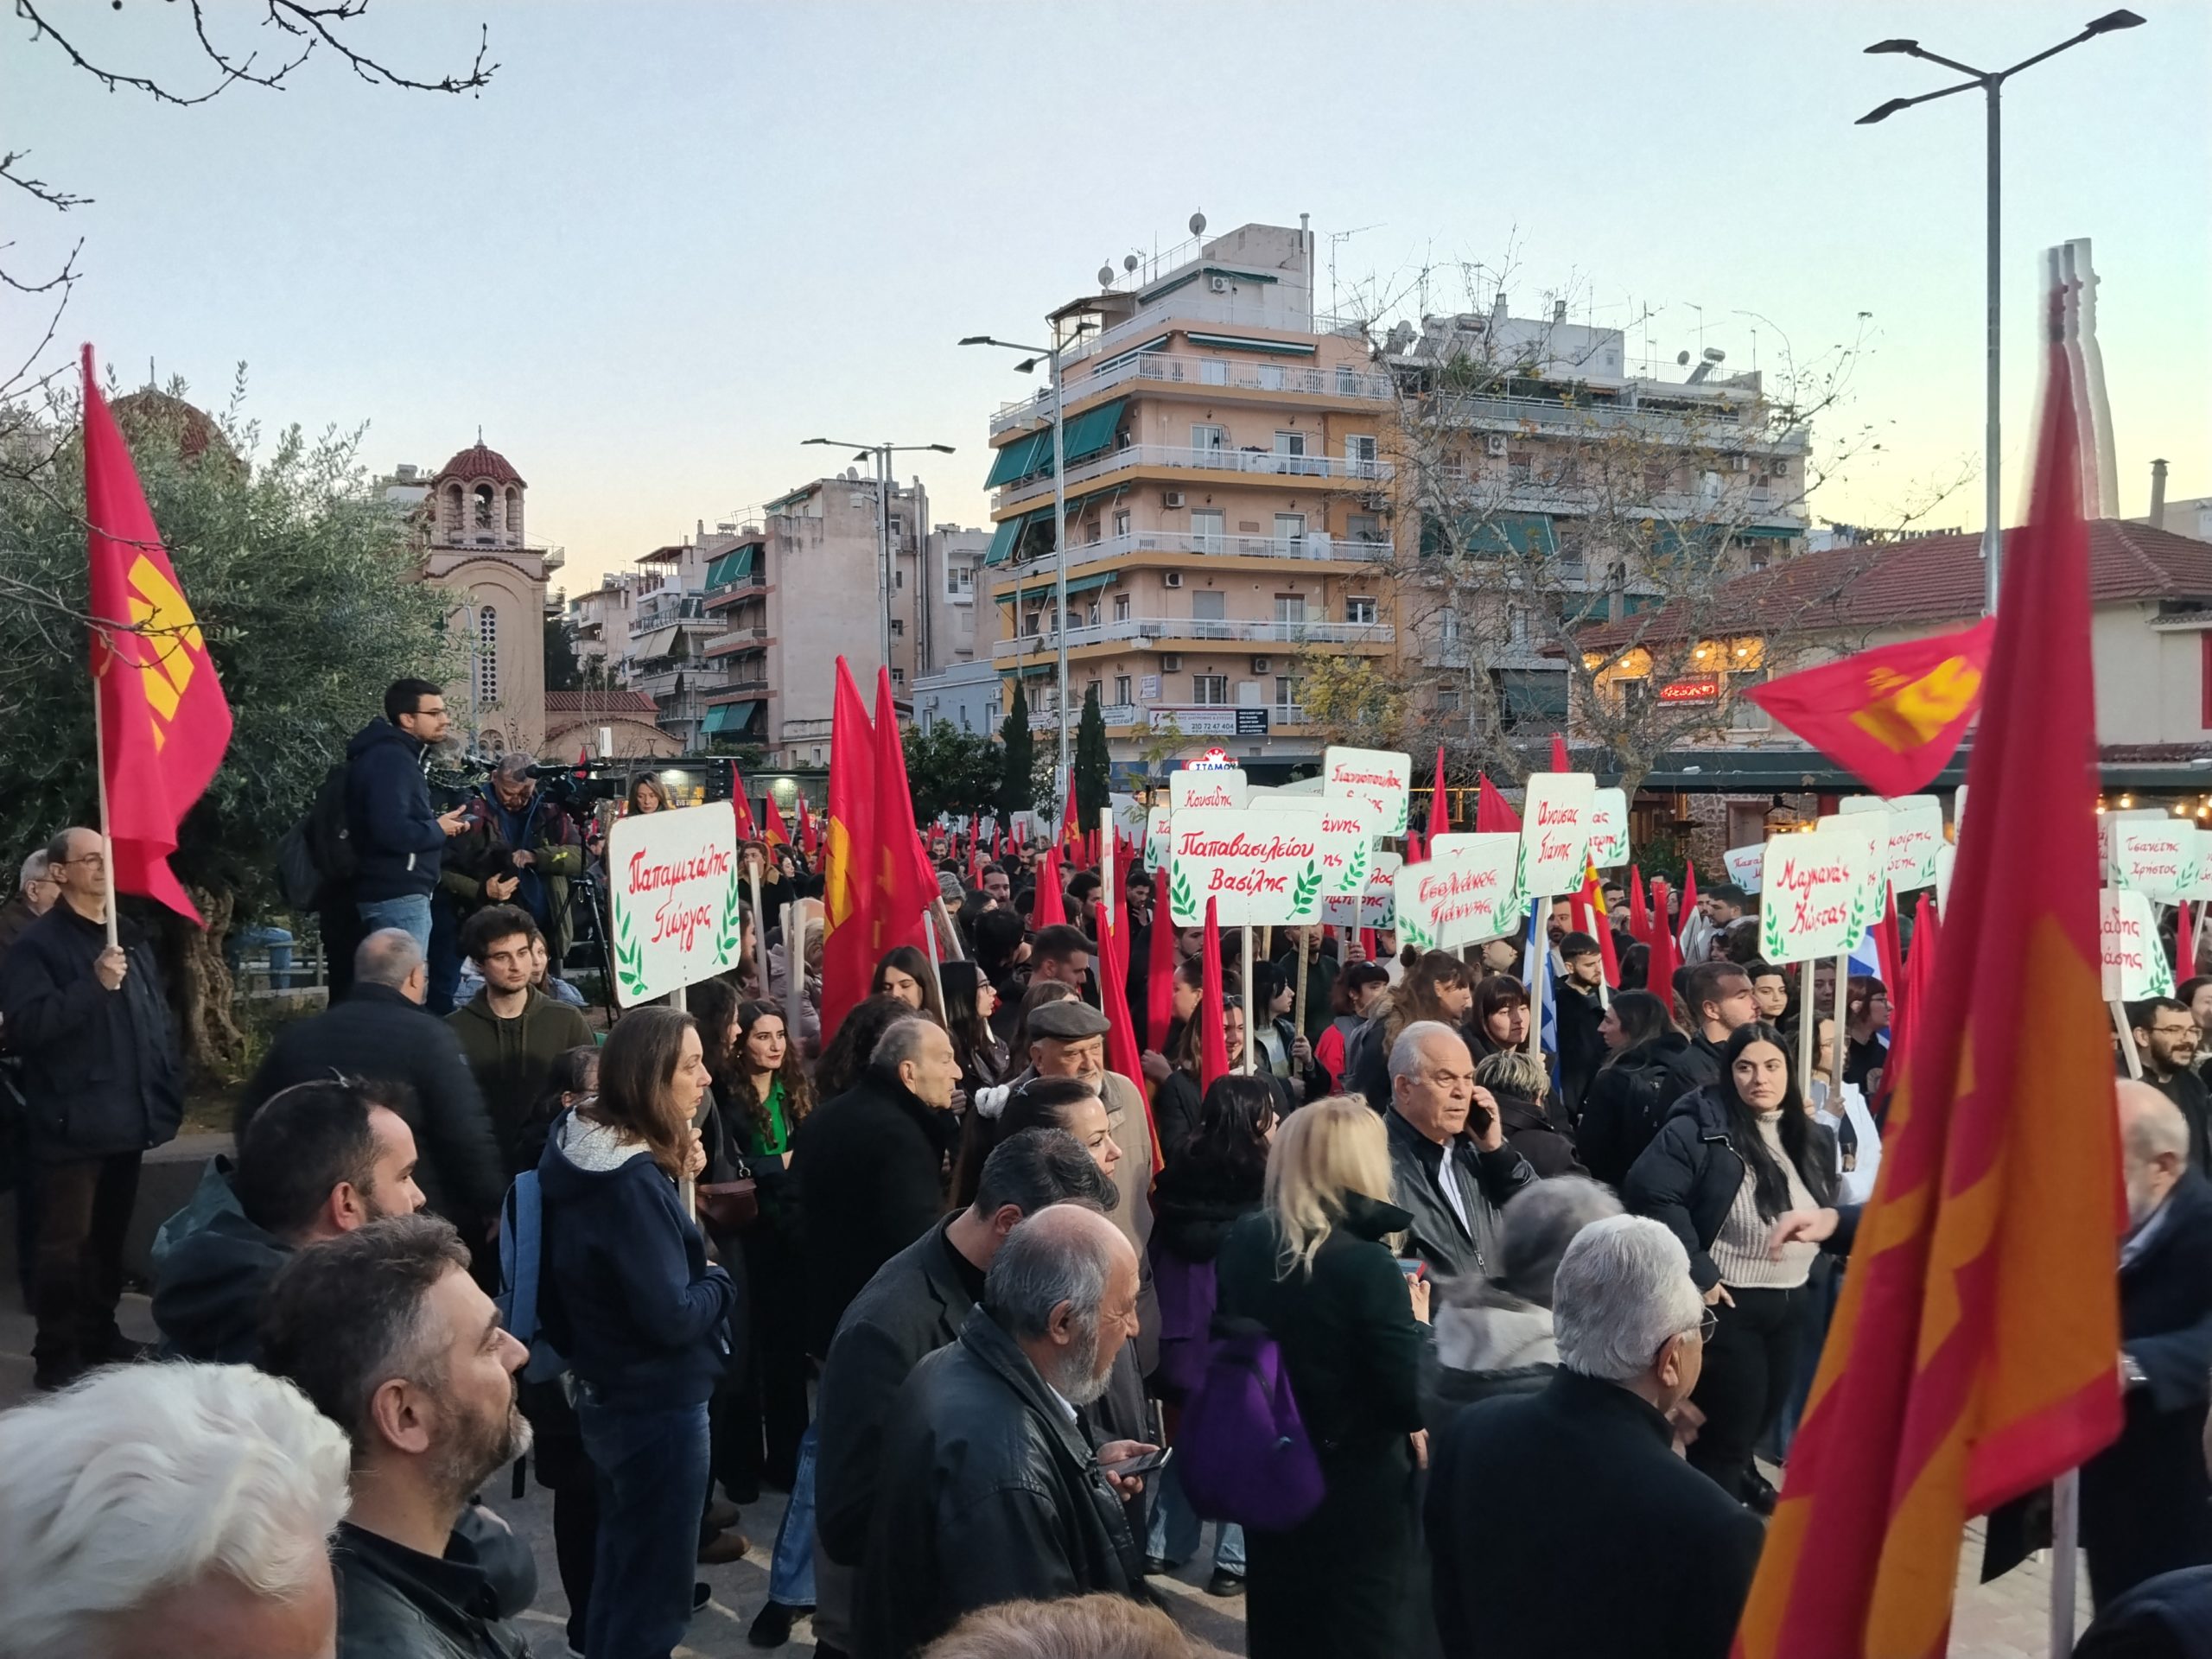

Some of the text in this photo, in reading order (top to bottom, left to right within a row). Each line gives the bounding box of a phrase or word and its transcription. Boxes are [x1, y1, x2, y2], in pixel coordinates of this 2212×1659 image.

[1321, 812, 1361, 834] άννης
[1178, 830, 1314, 863] Παπαβασιλείου
[628, 842, 732, 901] Παπαμιχάλης
[1208, 869, 1288, 897] Βασίλης
[651, 900, 713, 952] Γιώργος
[2103, 906, 2140, 938] άδης
[2104, 947, 2143, 969] άσης
